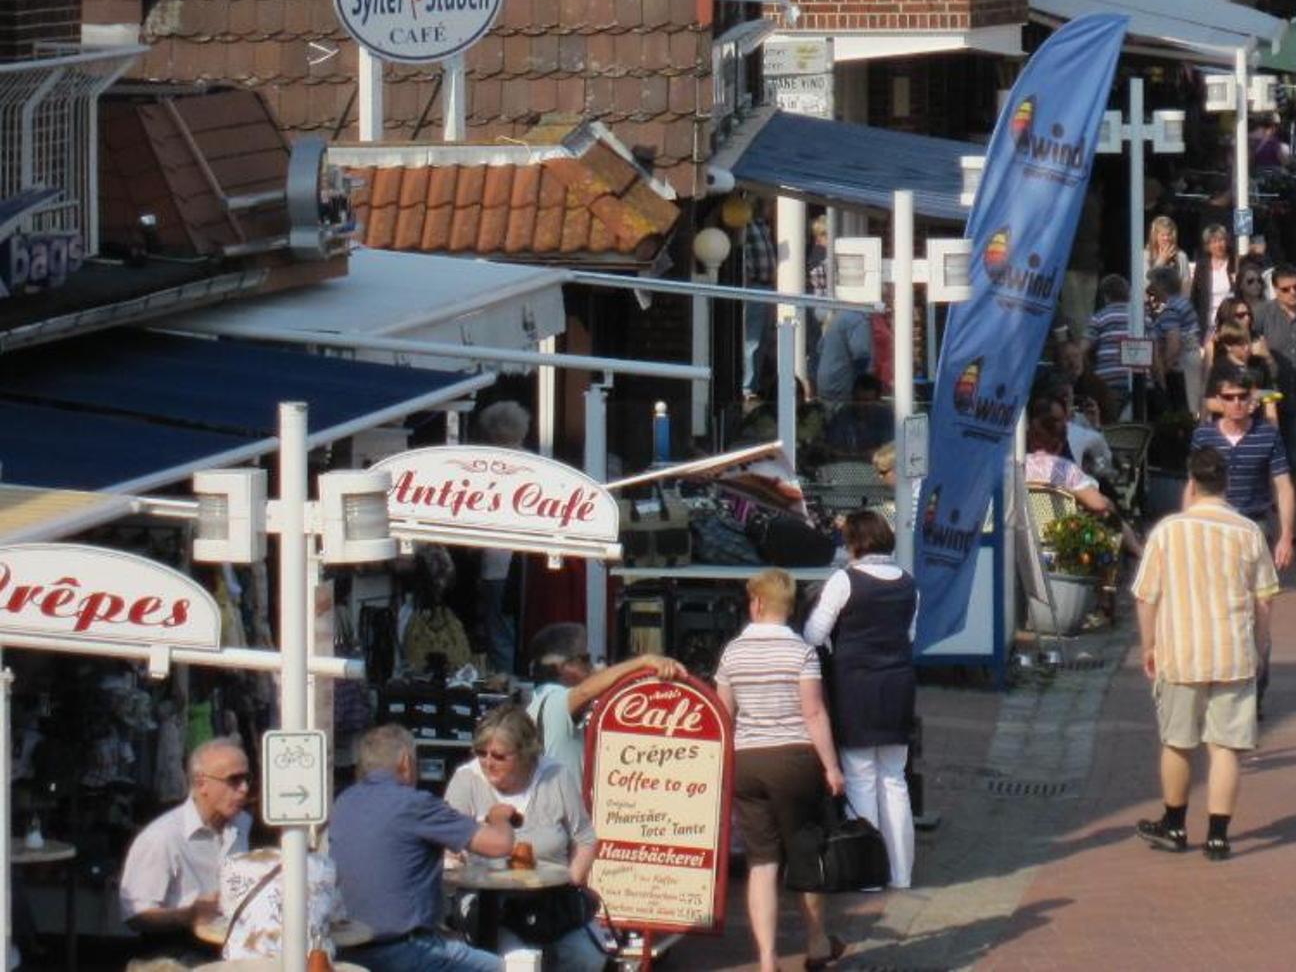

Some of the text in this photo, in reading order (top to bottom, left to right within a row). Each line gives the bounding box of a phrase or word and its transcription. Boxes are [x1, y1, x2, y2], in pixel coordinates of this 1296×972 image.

[389, 22, 446, 45] CAFÉ
[10, 235, 84, 289] bags
[389, 471, 599, 528] Antje's Café
[614, 693, 705, 736] Café
[607, 769, 707, 798] Coffee to go
[641, 823, 706, 837] Tote Tante
[599, 841, 706, 868] Hausbäckerei
